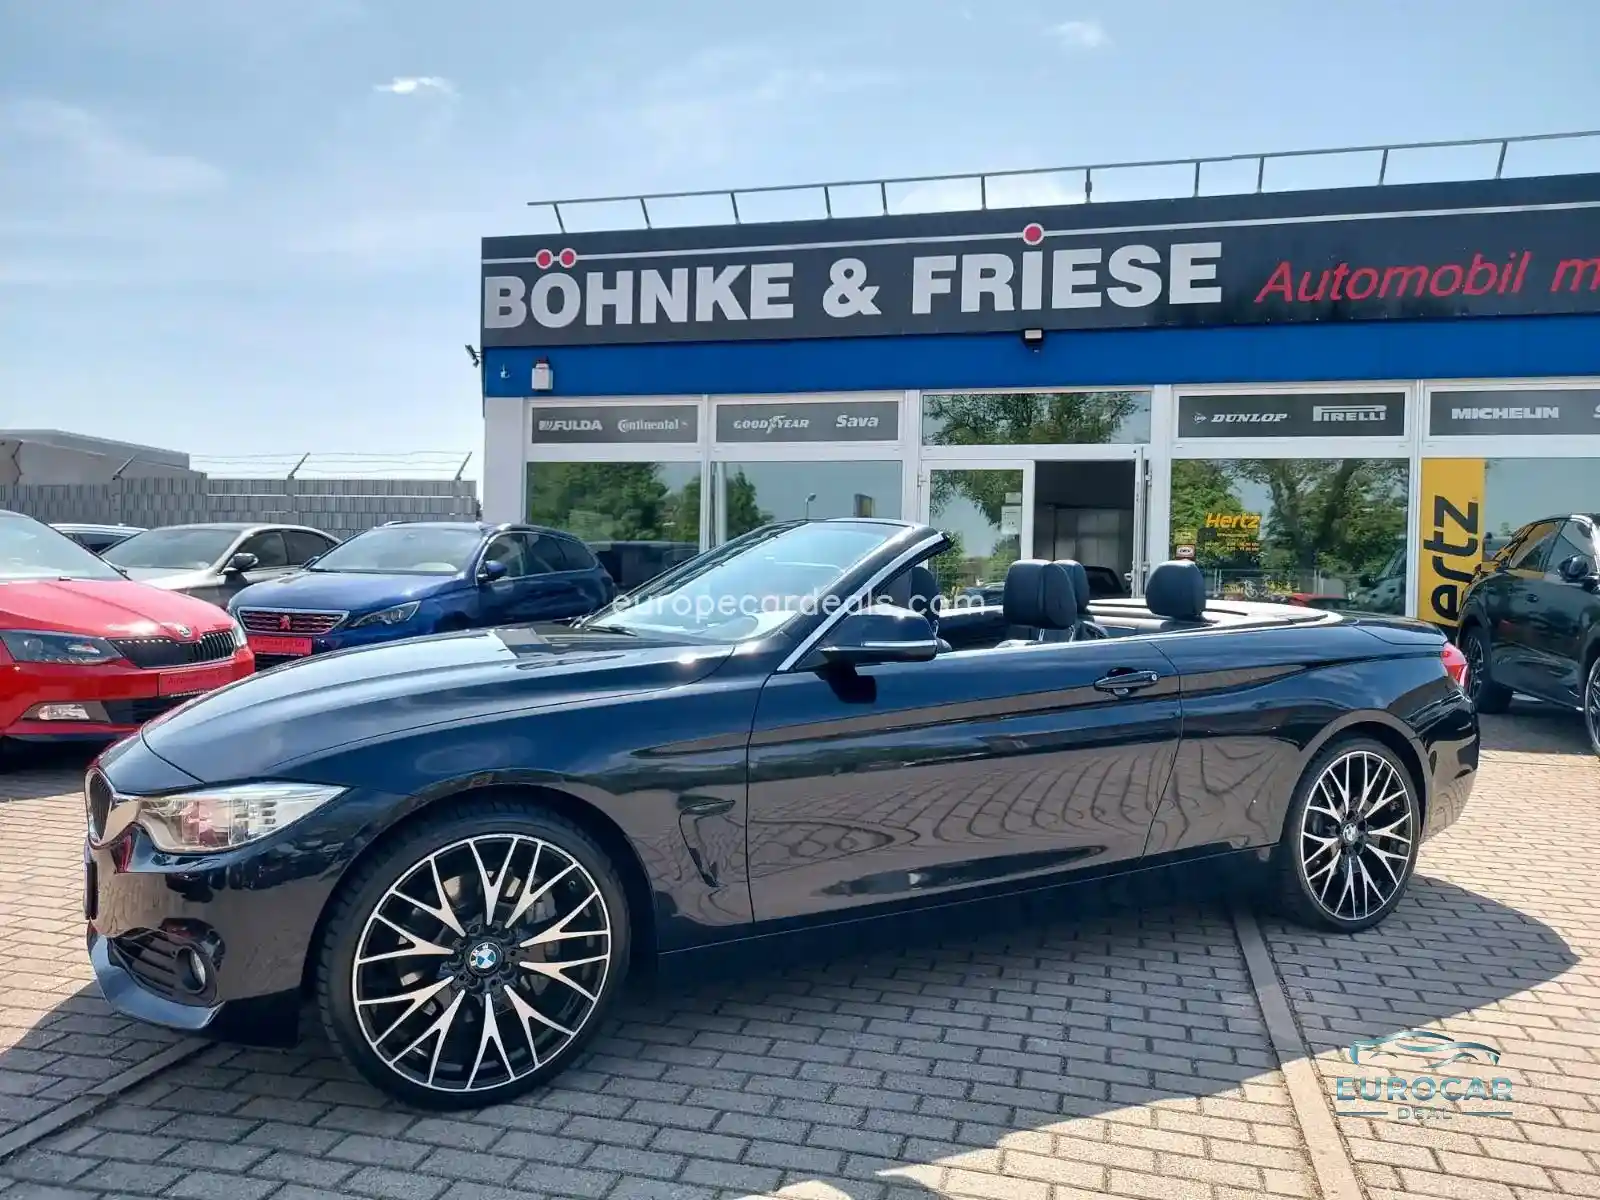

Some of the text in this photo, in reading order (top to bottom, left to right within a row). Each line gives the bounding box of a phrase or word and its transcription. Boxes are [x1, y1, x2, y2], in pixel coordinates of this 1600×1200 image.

[484, 223, 1222, 329] BÖHNKE & FRIESE
[1254, 250, 1533, 303] Automobil
[1210, 412, 1288, 423] DUNLOP
[1312, 404, 1387, 422] PIRELLI
[1451, 406, 1560, 420] MICHELIN
[546, 419, 604, 432] FULDA
[617, 418, 679, 433] Continental
[836, 414, 880, 428] Sava
[1205, 511, 1261, 529] Hertz
